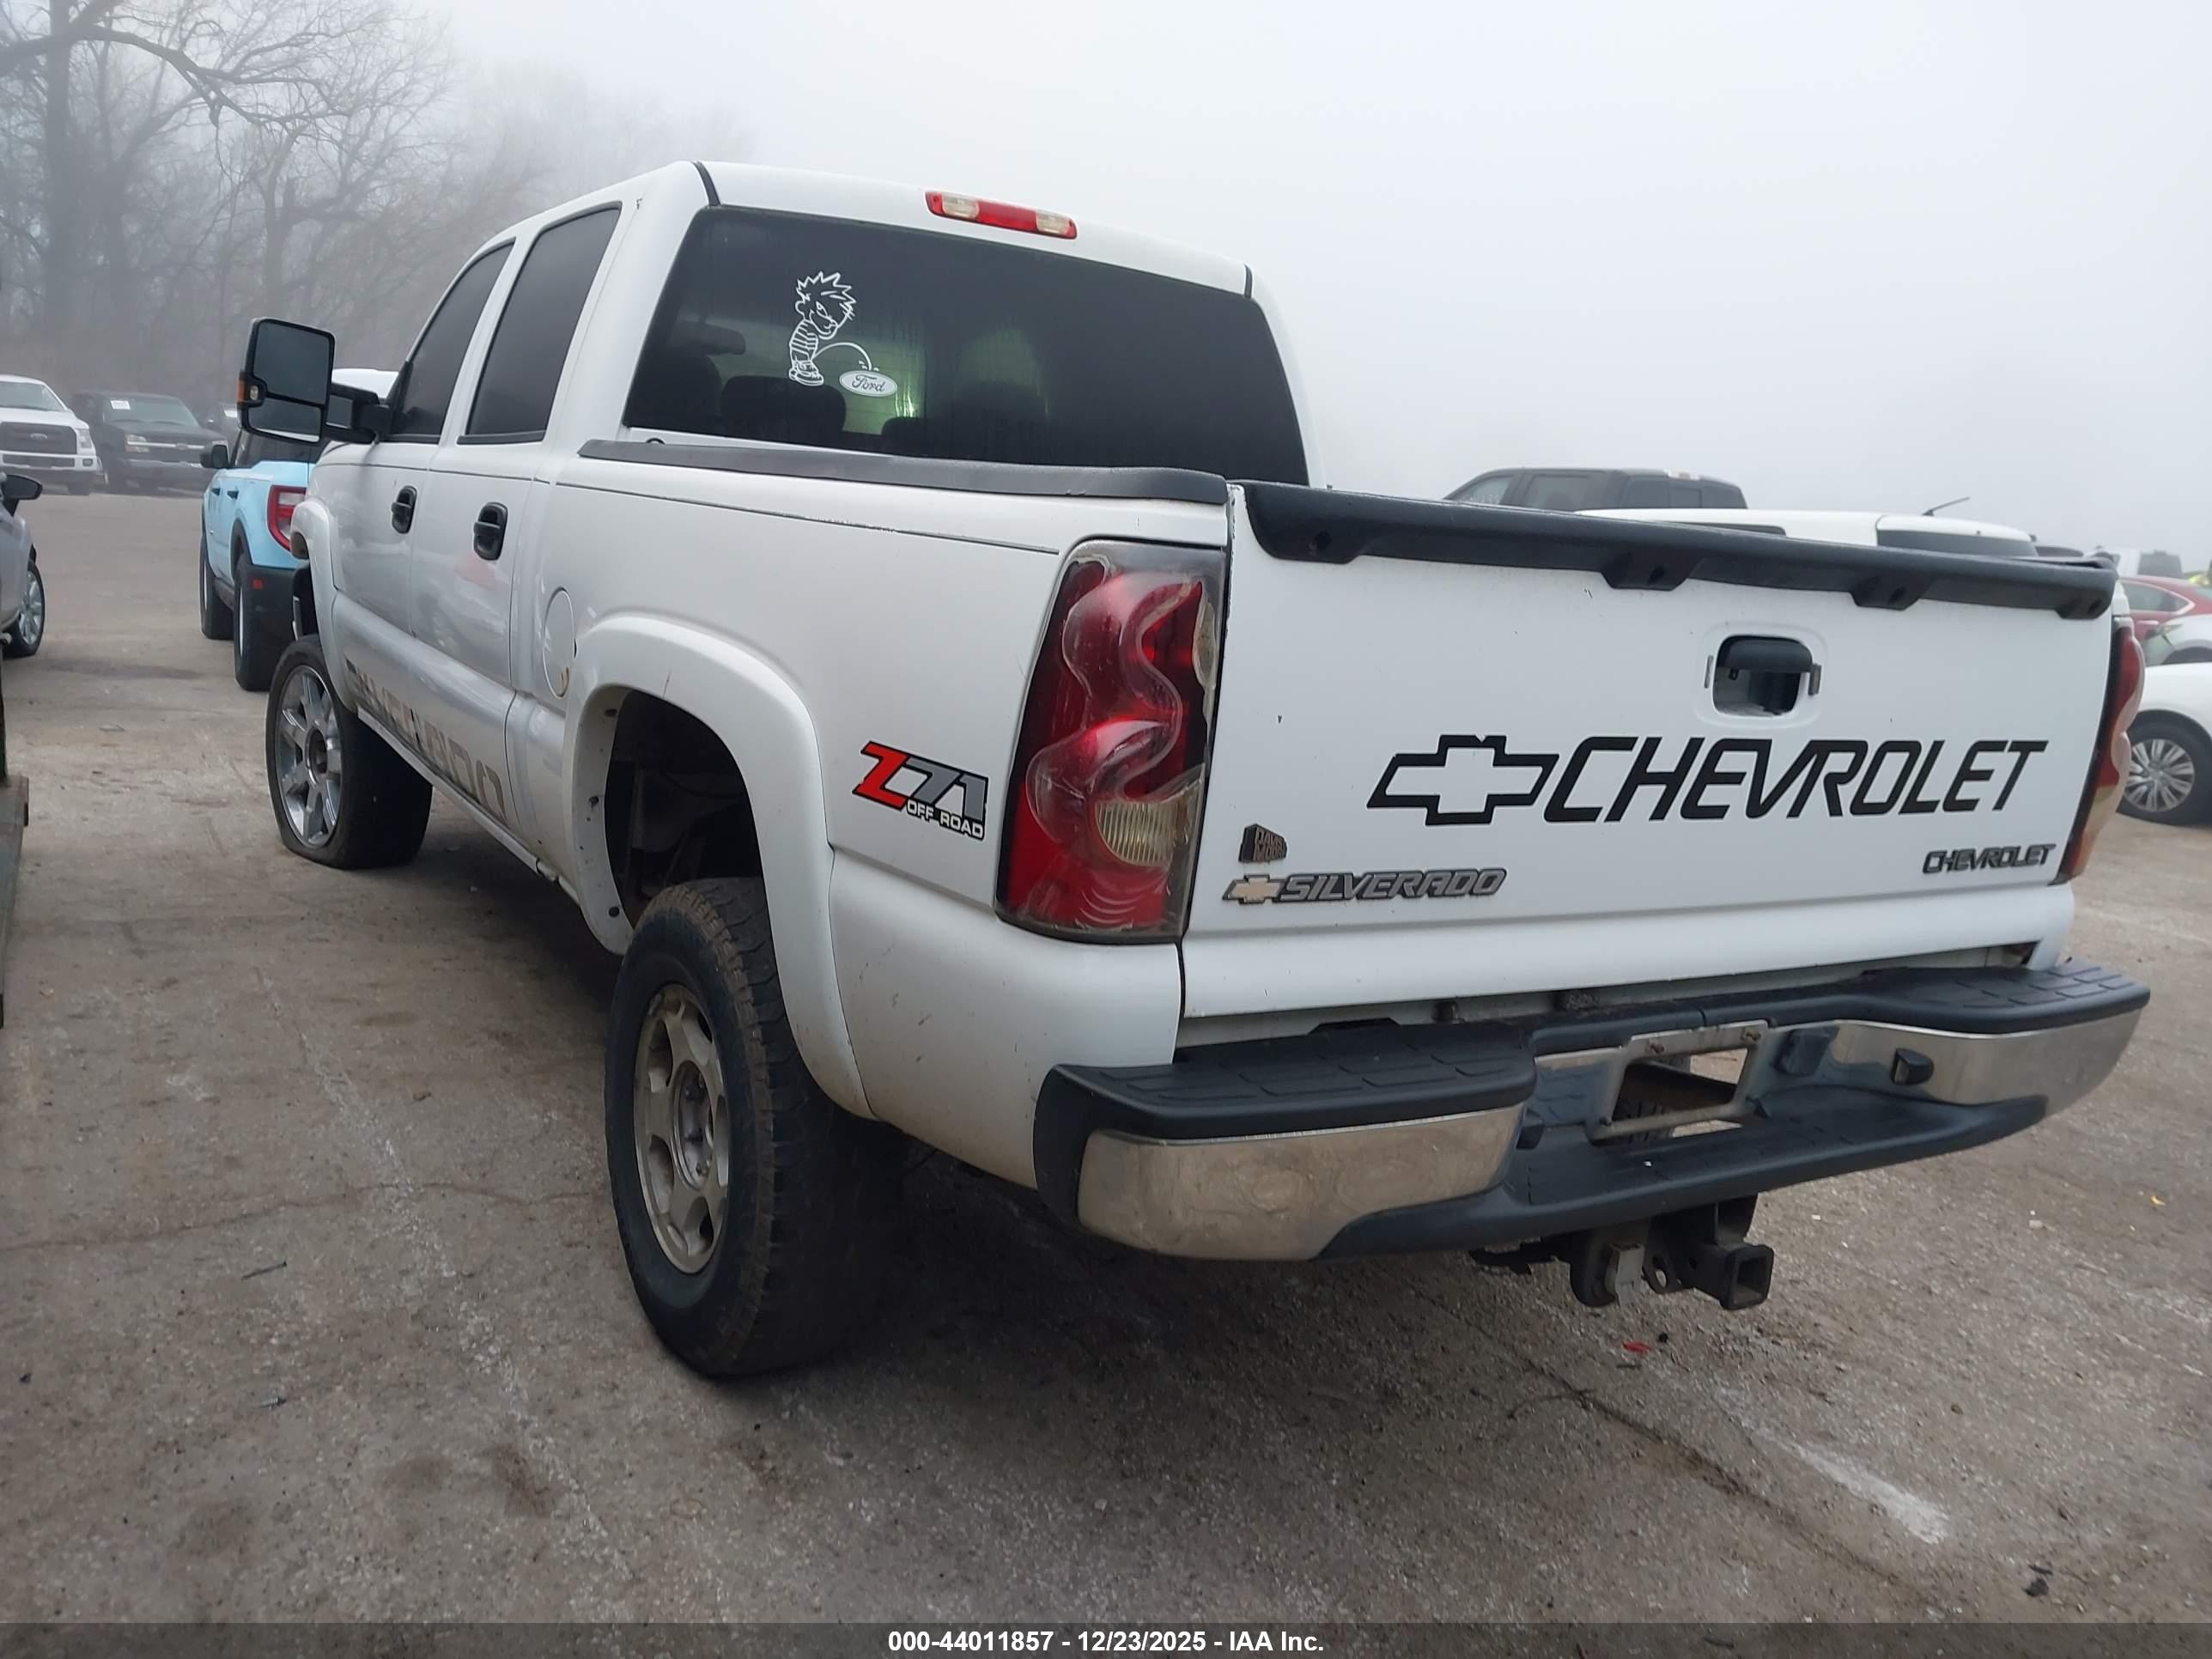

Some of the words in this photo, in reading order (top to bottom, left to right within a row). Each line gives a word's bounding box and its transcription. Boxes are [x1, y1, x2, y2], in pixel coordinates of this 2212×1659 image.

[851, 374, 886, 392] Ford
[852, 740, 989, 823] Z71
[1545, 736, 2049, 823] CHEVROLET
[907, 799, 934, 820] OFF
[940, 811, 984, 839] ROAD
[1922, 843, 2057, 874] CHEVROLET
[1274, 868, 1508, 902] SILVERADO
